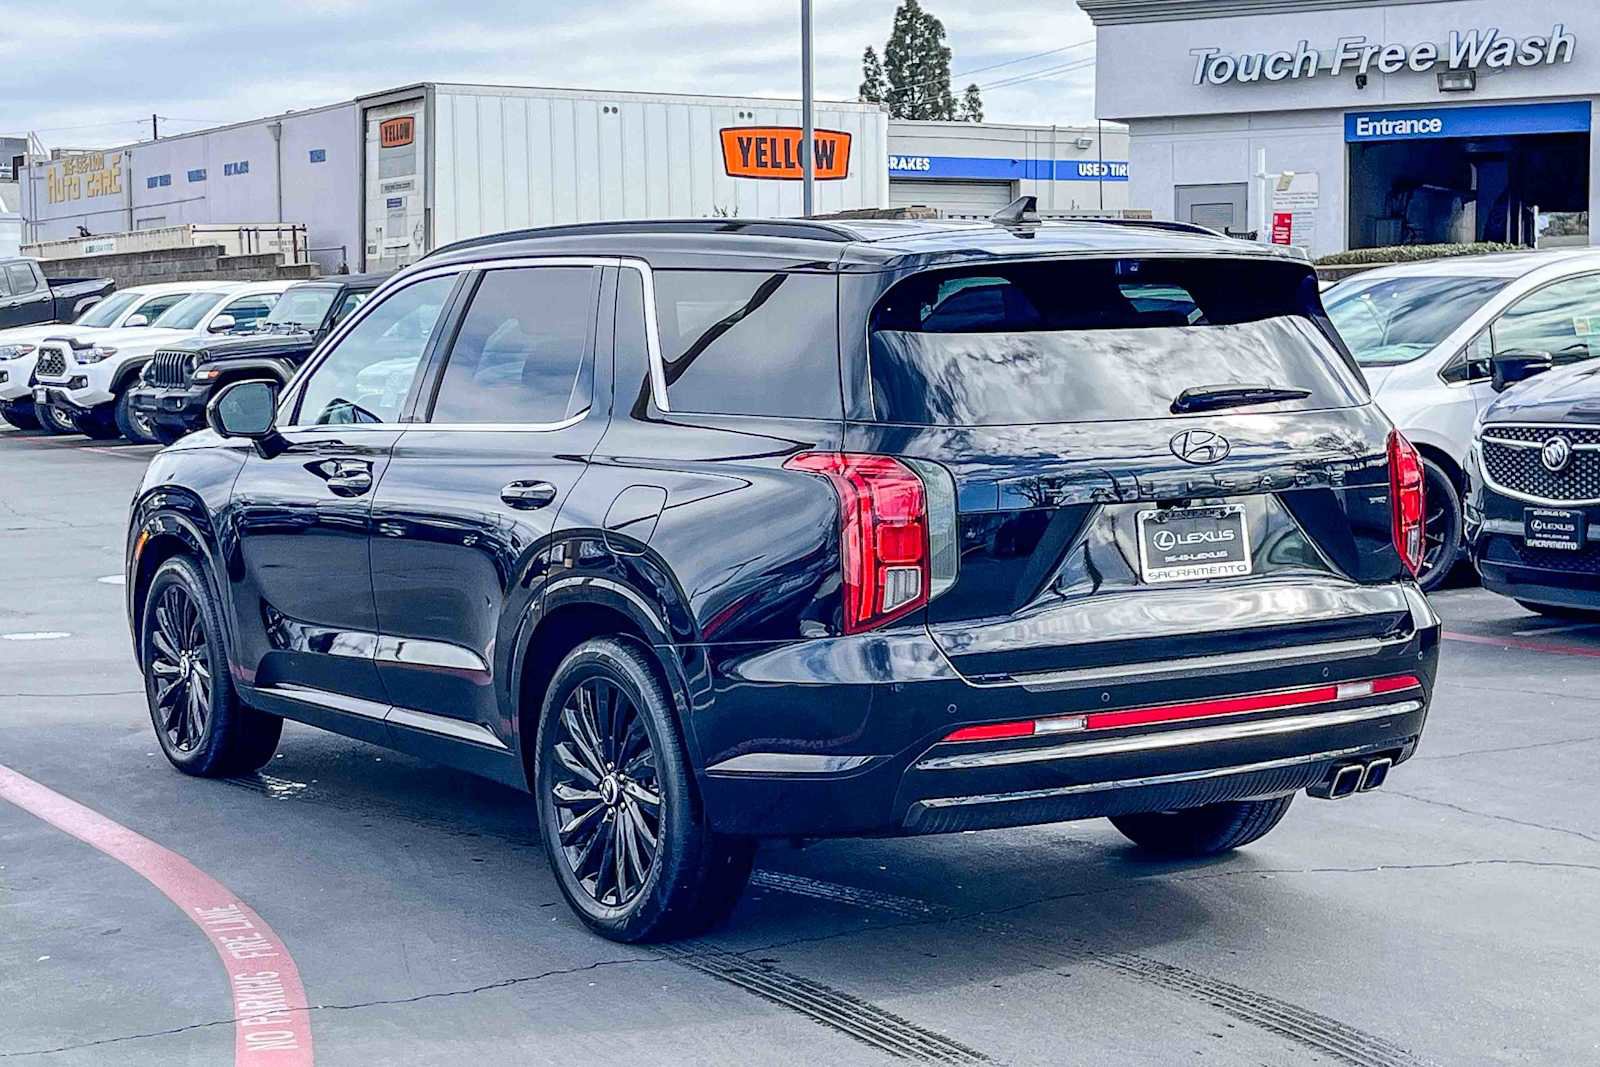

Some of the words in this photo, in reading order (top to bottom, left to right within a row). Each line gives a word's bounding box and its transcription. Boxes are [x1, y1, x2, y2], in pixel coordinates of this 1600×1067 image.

[1190, 40, 1319, 85] Touch
[1331, 36, 1439, 76] Free
[1448, 24, 1576, 69] Wash
[384, 122, 410, 142] YELLOW
[1356, 117, 1442, 136] Entrance
[888, 156, 930, 170] RAKES
[1078, 162, 1109, 177] USED
[1109, 163, 1128, 177] TIR
[1542, 522, 1574, 531] LEXUS
[1177, 529, 1236, 546] LEXUS
[1526, 539, 1577, 550] SACRAMENTO
[1148, 564, 1248, 581] SACRAMENTO
[195, 904, 254, 932] LANE
[219, 932, 280, 959] FIRE
[235, 971, 292, 1026] PARKING
[244, 1030, 299, 1051] NO
